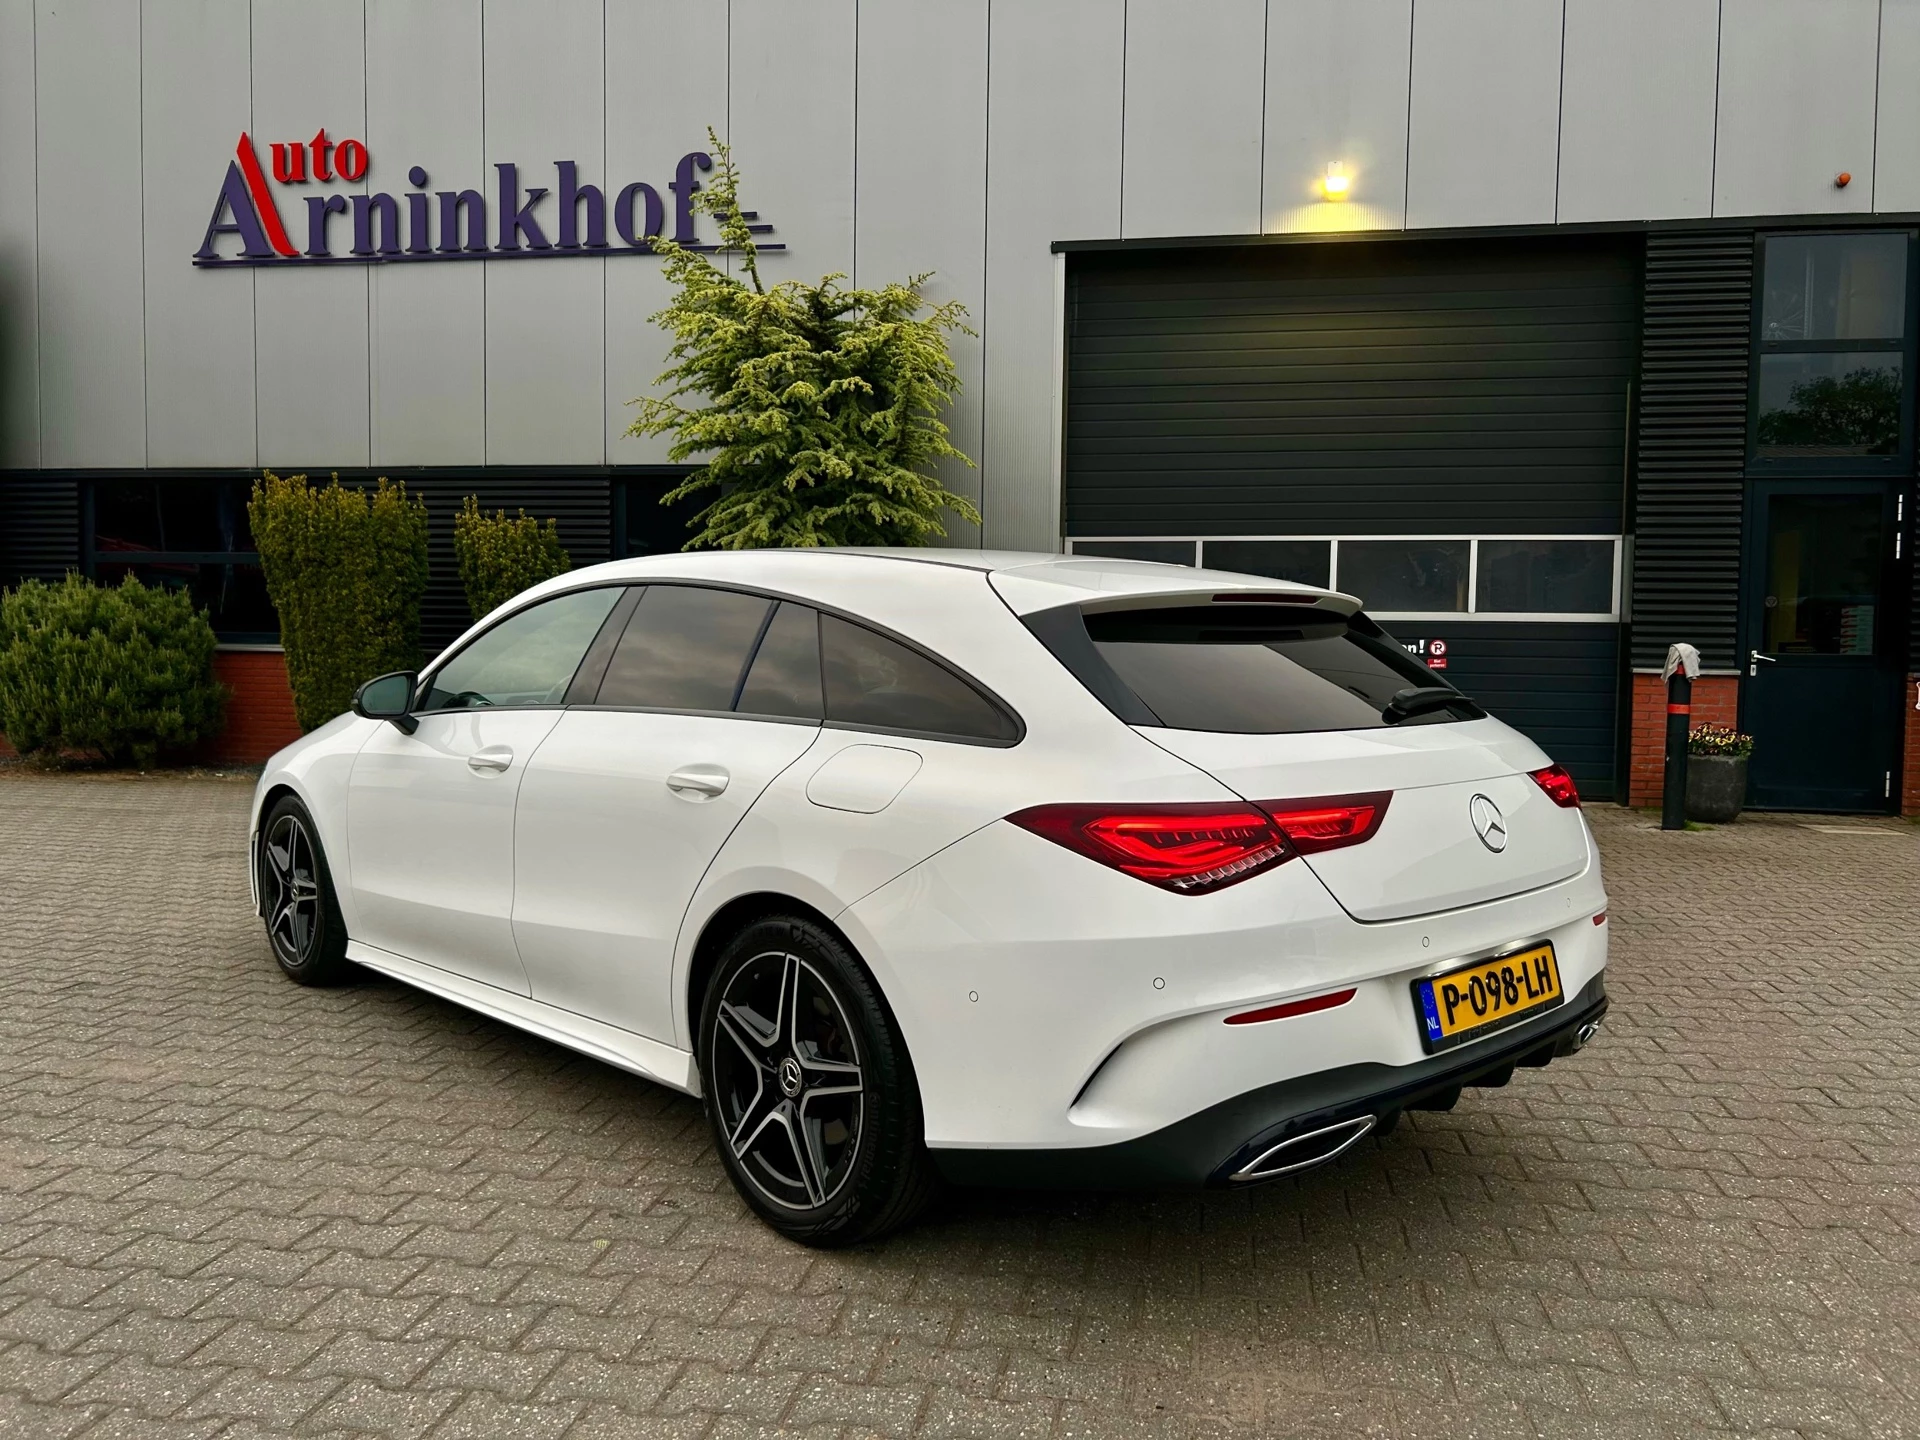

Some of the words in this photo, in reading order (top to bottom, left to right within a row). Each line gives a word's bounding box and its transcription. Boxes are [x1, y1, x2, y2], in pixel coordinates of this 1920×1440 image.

[194, 136, 711, 258] Arninkhof
[1427, 1016, 1439, 1031] NL
[1442, 955, 1553, 1026] P-098-LH
